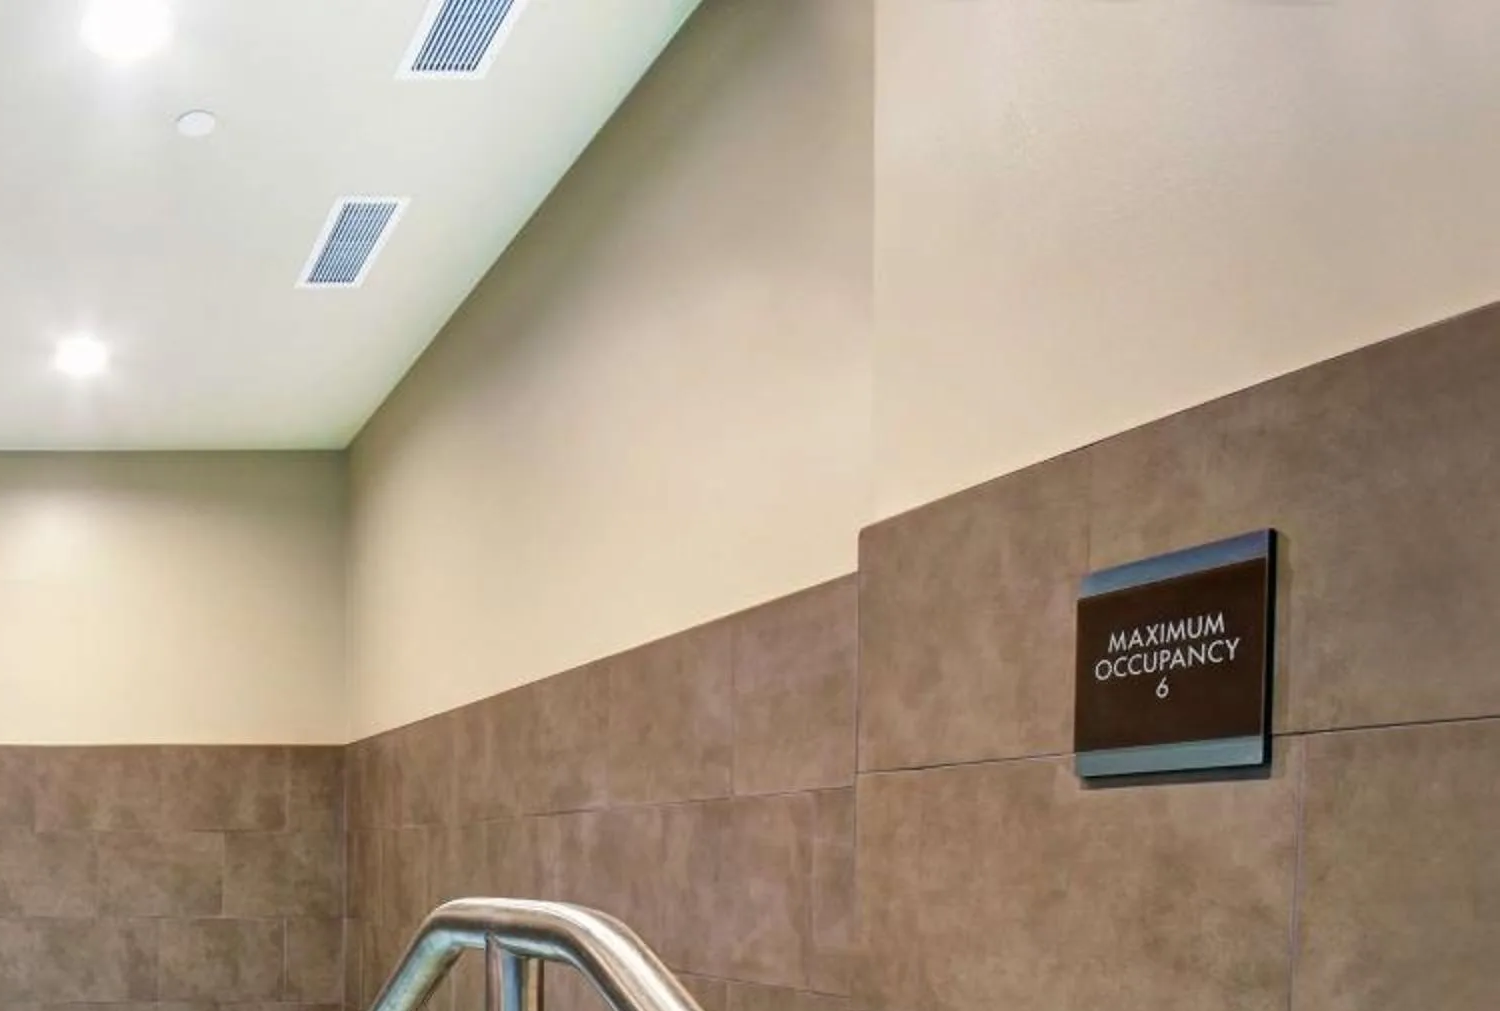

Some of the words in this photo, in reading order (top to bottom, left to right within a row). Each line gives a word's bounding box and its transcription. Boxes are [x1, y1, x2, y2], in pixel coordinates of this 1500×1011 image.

[1107, 611, 1226, 654] MAXIMUM
[1094, 637, 1240, 682] OCCUPANCY
[1155, 676, 1170, 699] 6
